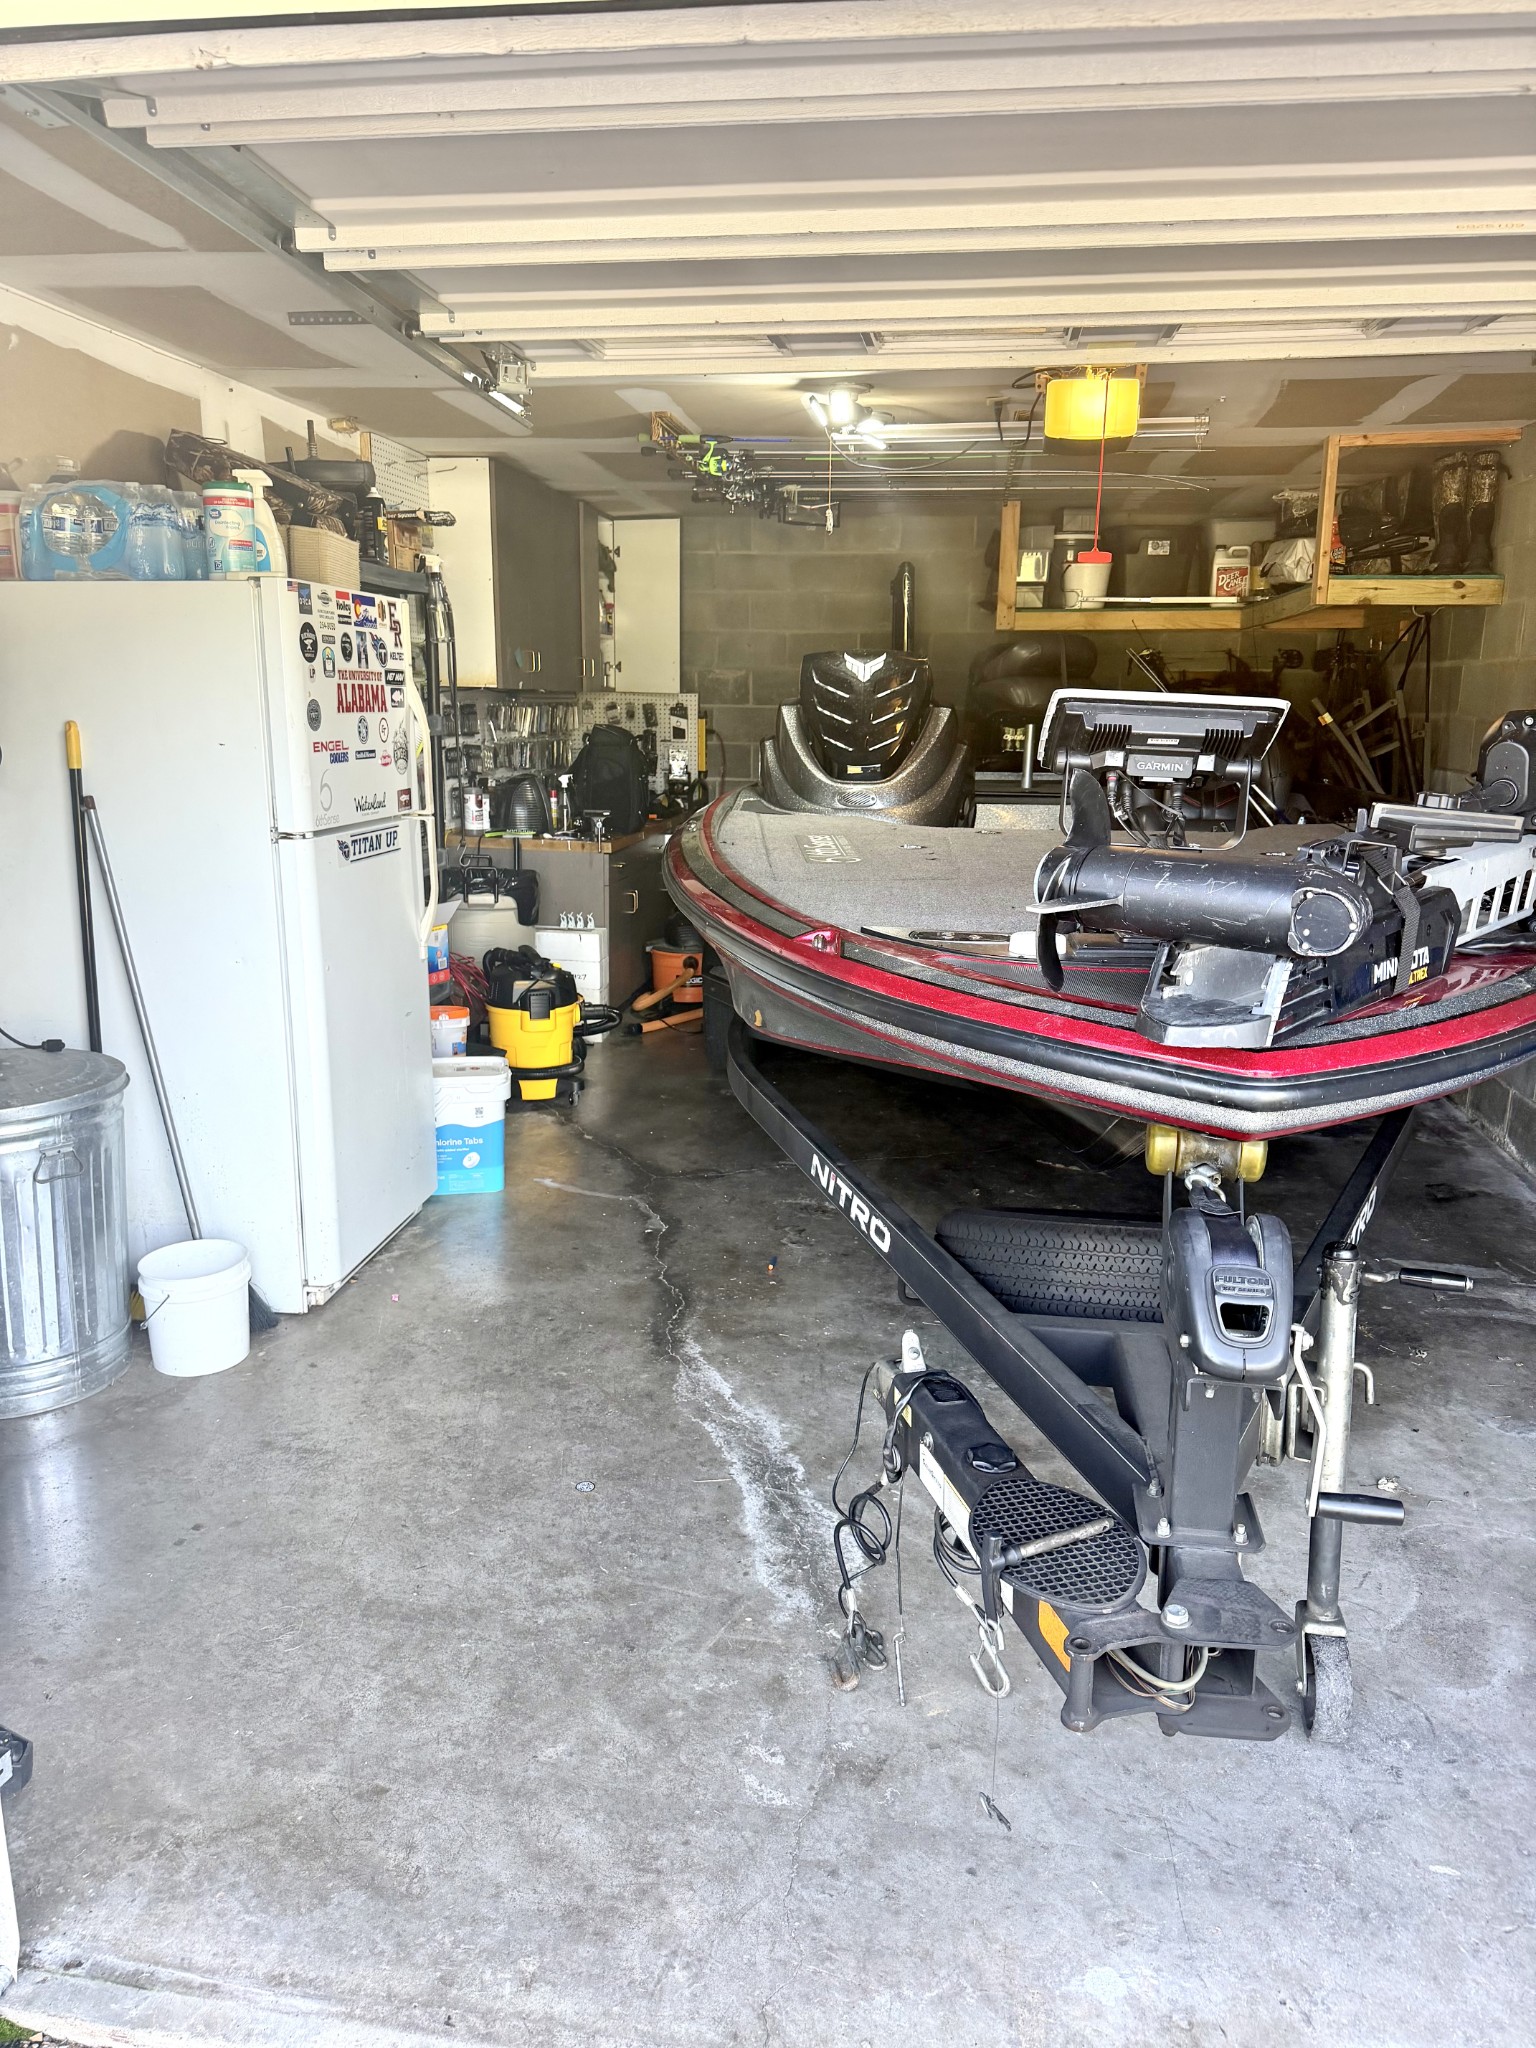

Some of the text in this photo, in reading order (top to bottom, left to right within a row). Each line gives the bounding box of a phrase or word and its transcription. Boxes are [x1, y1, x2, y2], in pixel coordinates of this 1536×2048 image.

[1218, 571, 1240, 587] DEER
[1223, 576, 1243, 591] CANE
[338, 669, 349, 680] THE
[348, 670, 377, 682] UNIVERSITY
[337, 683, 388, 713] ALABAMA
[313, 740, 349, 753] ENGEL
[329, 752, 349, 764] COOLERS
[1136, 761, 1184, 772] GARMIN
[350, 830, 398, 856] TITAN UP
[464, 1137, 484, 1145] Tabs
[810, 1153, 891, 1253] NITRO
[1215, 1275, 1270, 1286] FULTON
